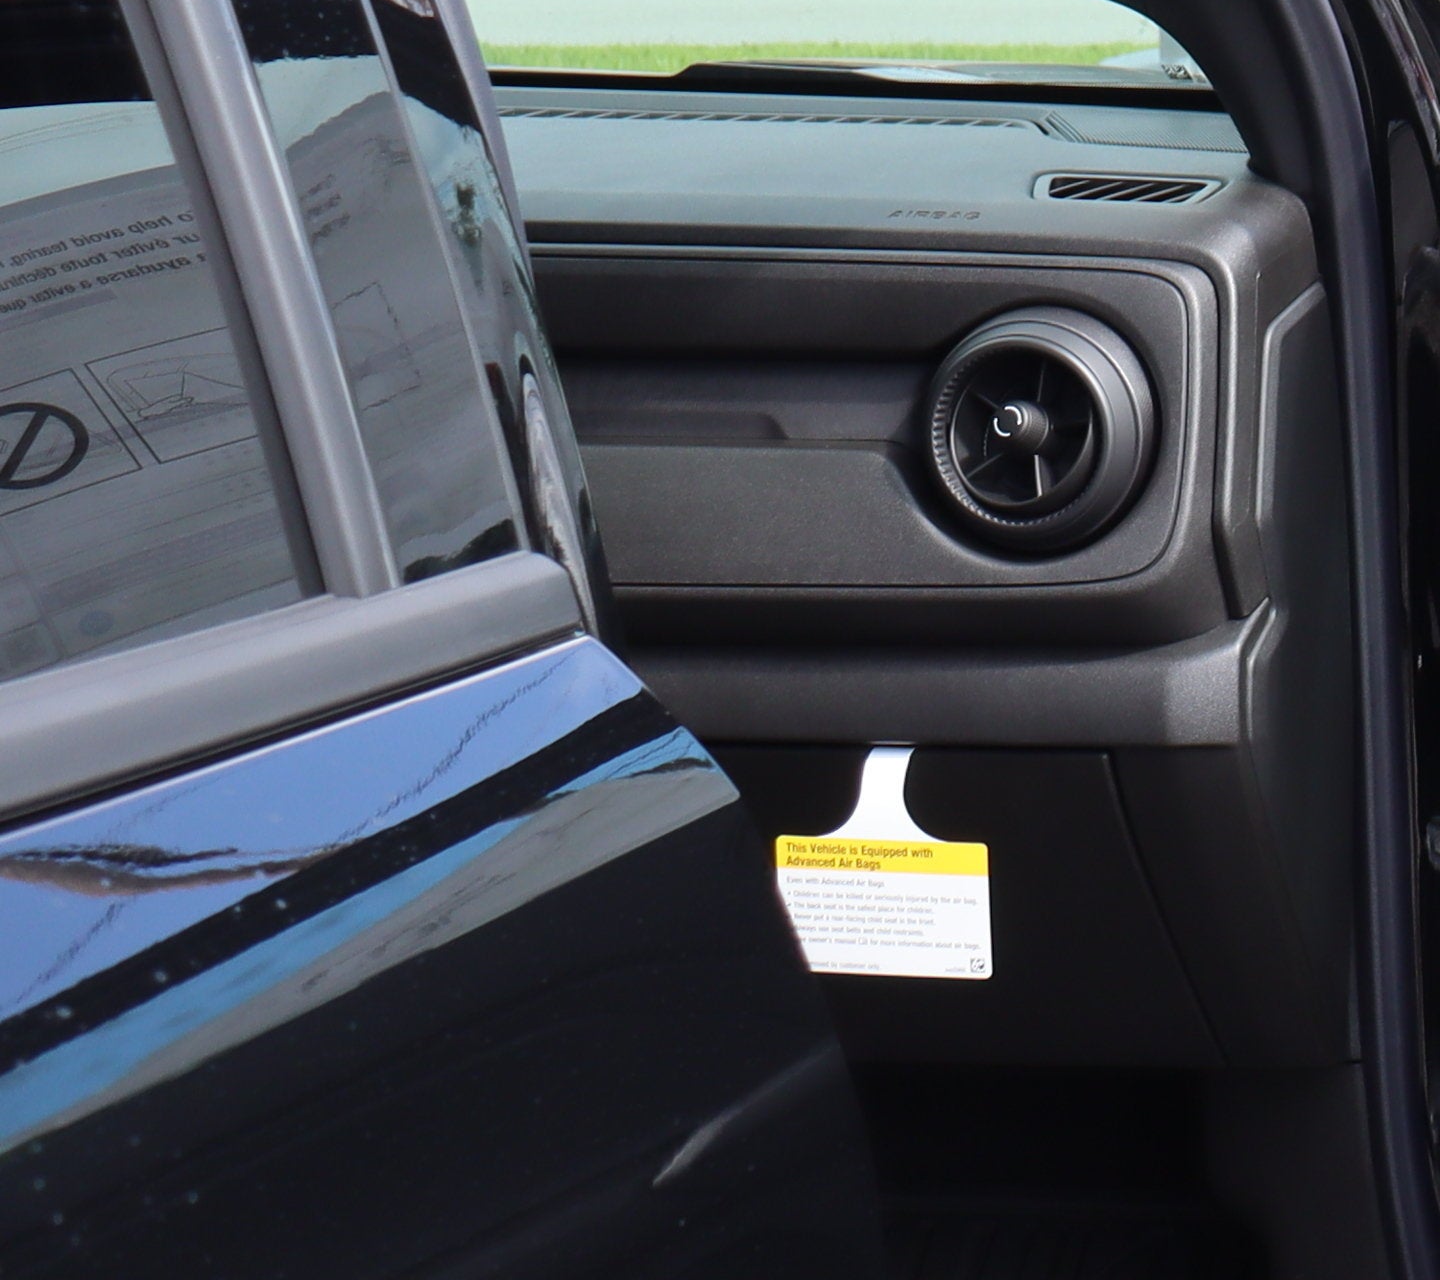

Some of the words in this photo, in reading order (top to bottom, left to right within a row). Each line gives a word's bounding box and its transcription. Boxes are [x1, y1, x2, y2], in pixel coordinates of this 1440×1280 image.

[786, 842, 807, 853] This
[810, 843, 847, 855] Vehicle
[849, 844, 858, 855] is
[861, 845, 908, 858] Equipped
[911, 847, 933, 858] with
[786, 856, 835, 867] Advanced
[838, 858, 853, 868] Air
[855, 858, 881, 871] Bags
